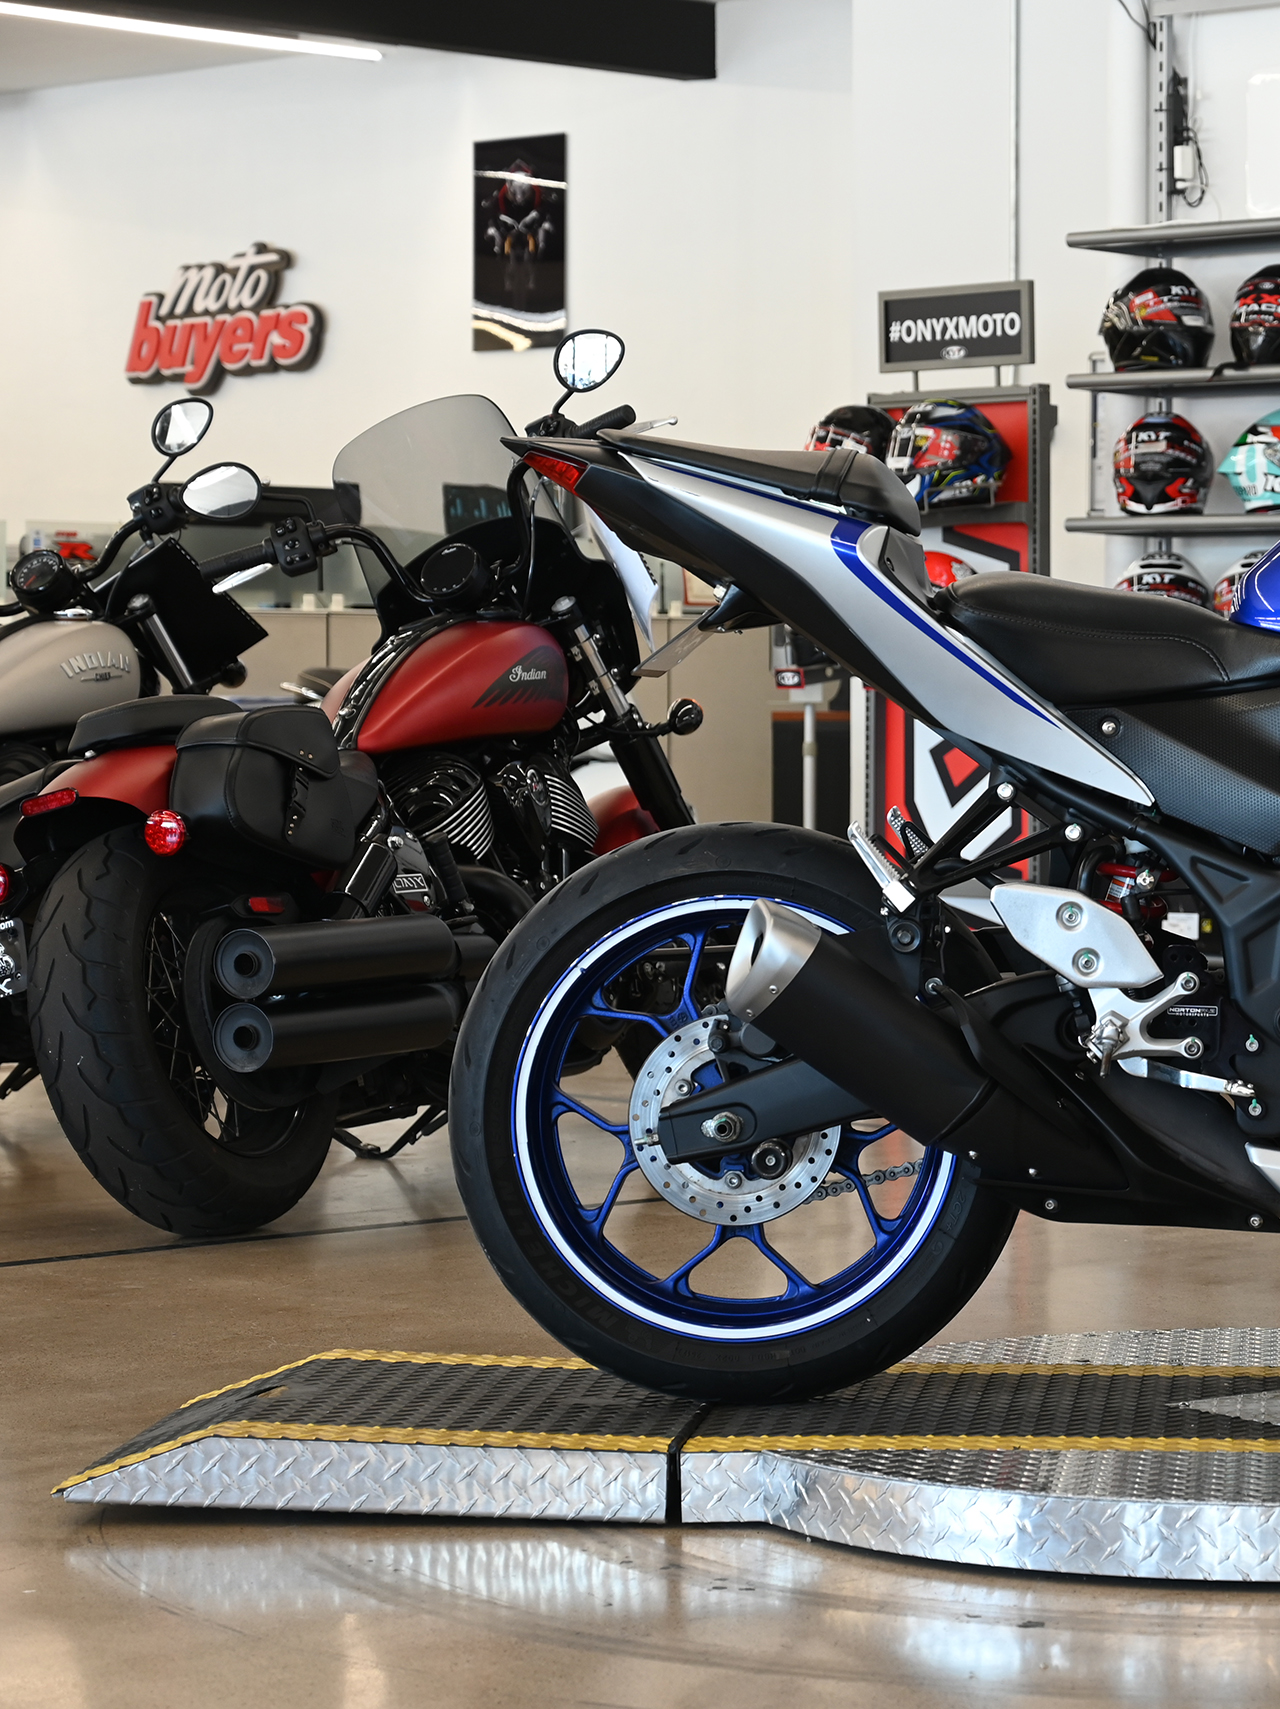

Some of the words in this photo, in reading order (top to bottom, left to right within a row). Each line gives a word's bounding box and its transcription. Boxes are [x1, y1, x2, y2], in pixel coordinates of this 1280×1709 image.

[889, 311, 1021, 344] #ONYXMOTO
[125, 297, 312, 388] buyers
[1137, 430, 1172, 442] KYT
[60, 651, 131, 678] INDIAN
[509, 665, 547, 682] Indian
